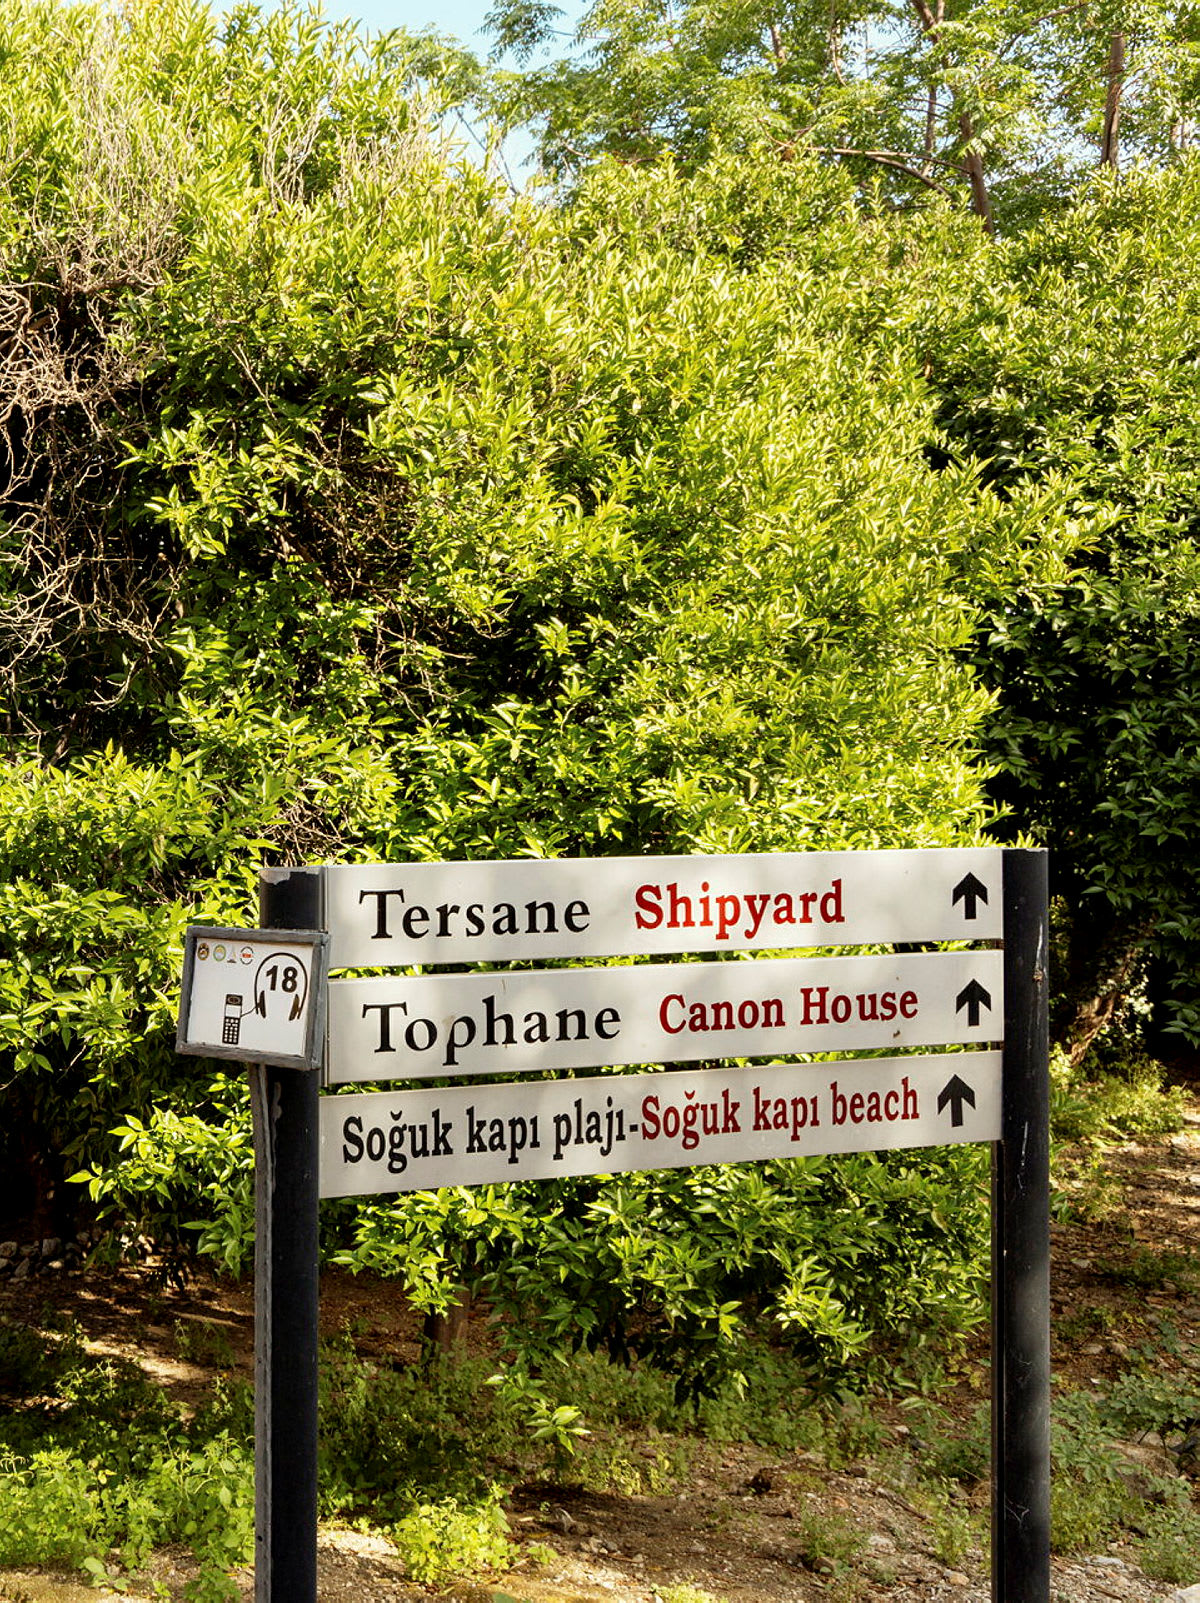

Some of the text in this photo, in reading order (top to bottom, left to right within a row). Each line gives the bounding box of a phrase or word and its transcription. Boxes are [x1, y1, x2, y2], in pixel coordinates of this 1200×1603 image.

[359, 879, 846, 941] Tersane Shipyard
[265, 964, 299, 993] 18
[362, 986, 919, 1067] Tophane Canon House
[342, 1108, 454, 1175] Soğuk
[466, 1105, 541, 1165] kapı
[752, 1085, 821, 1142] kapı
[830, 1076, 920, 1127] beach
